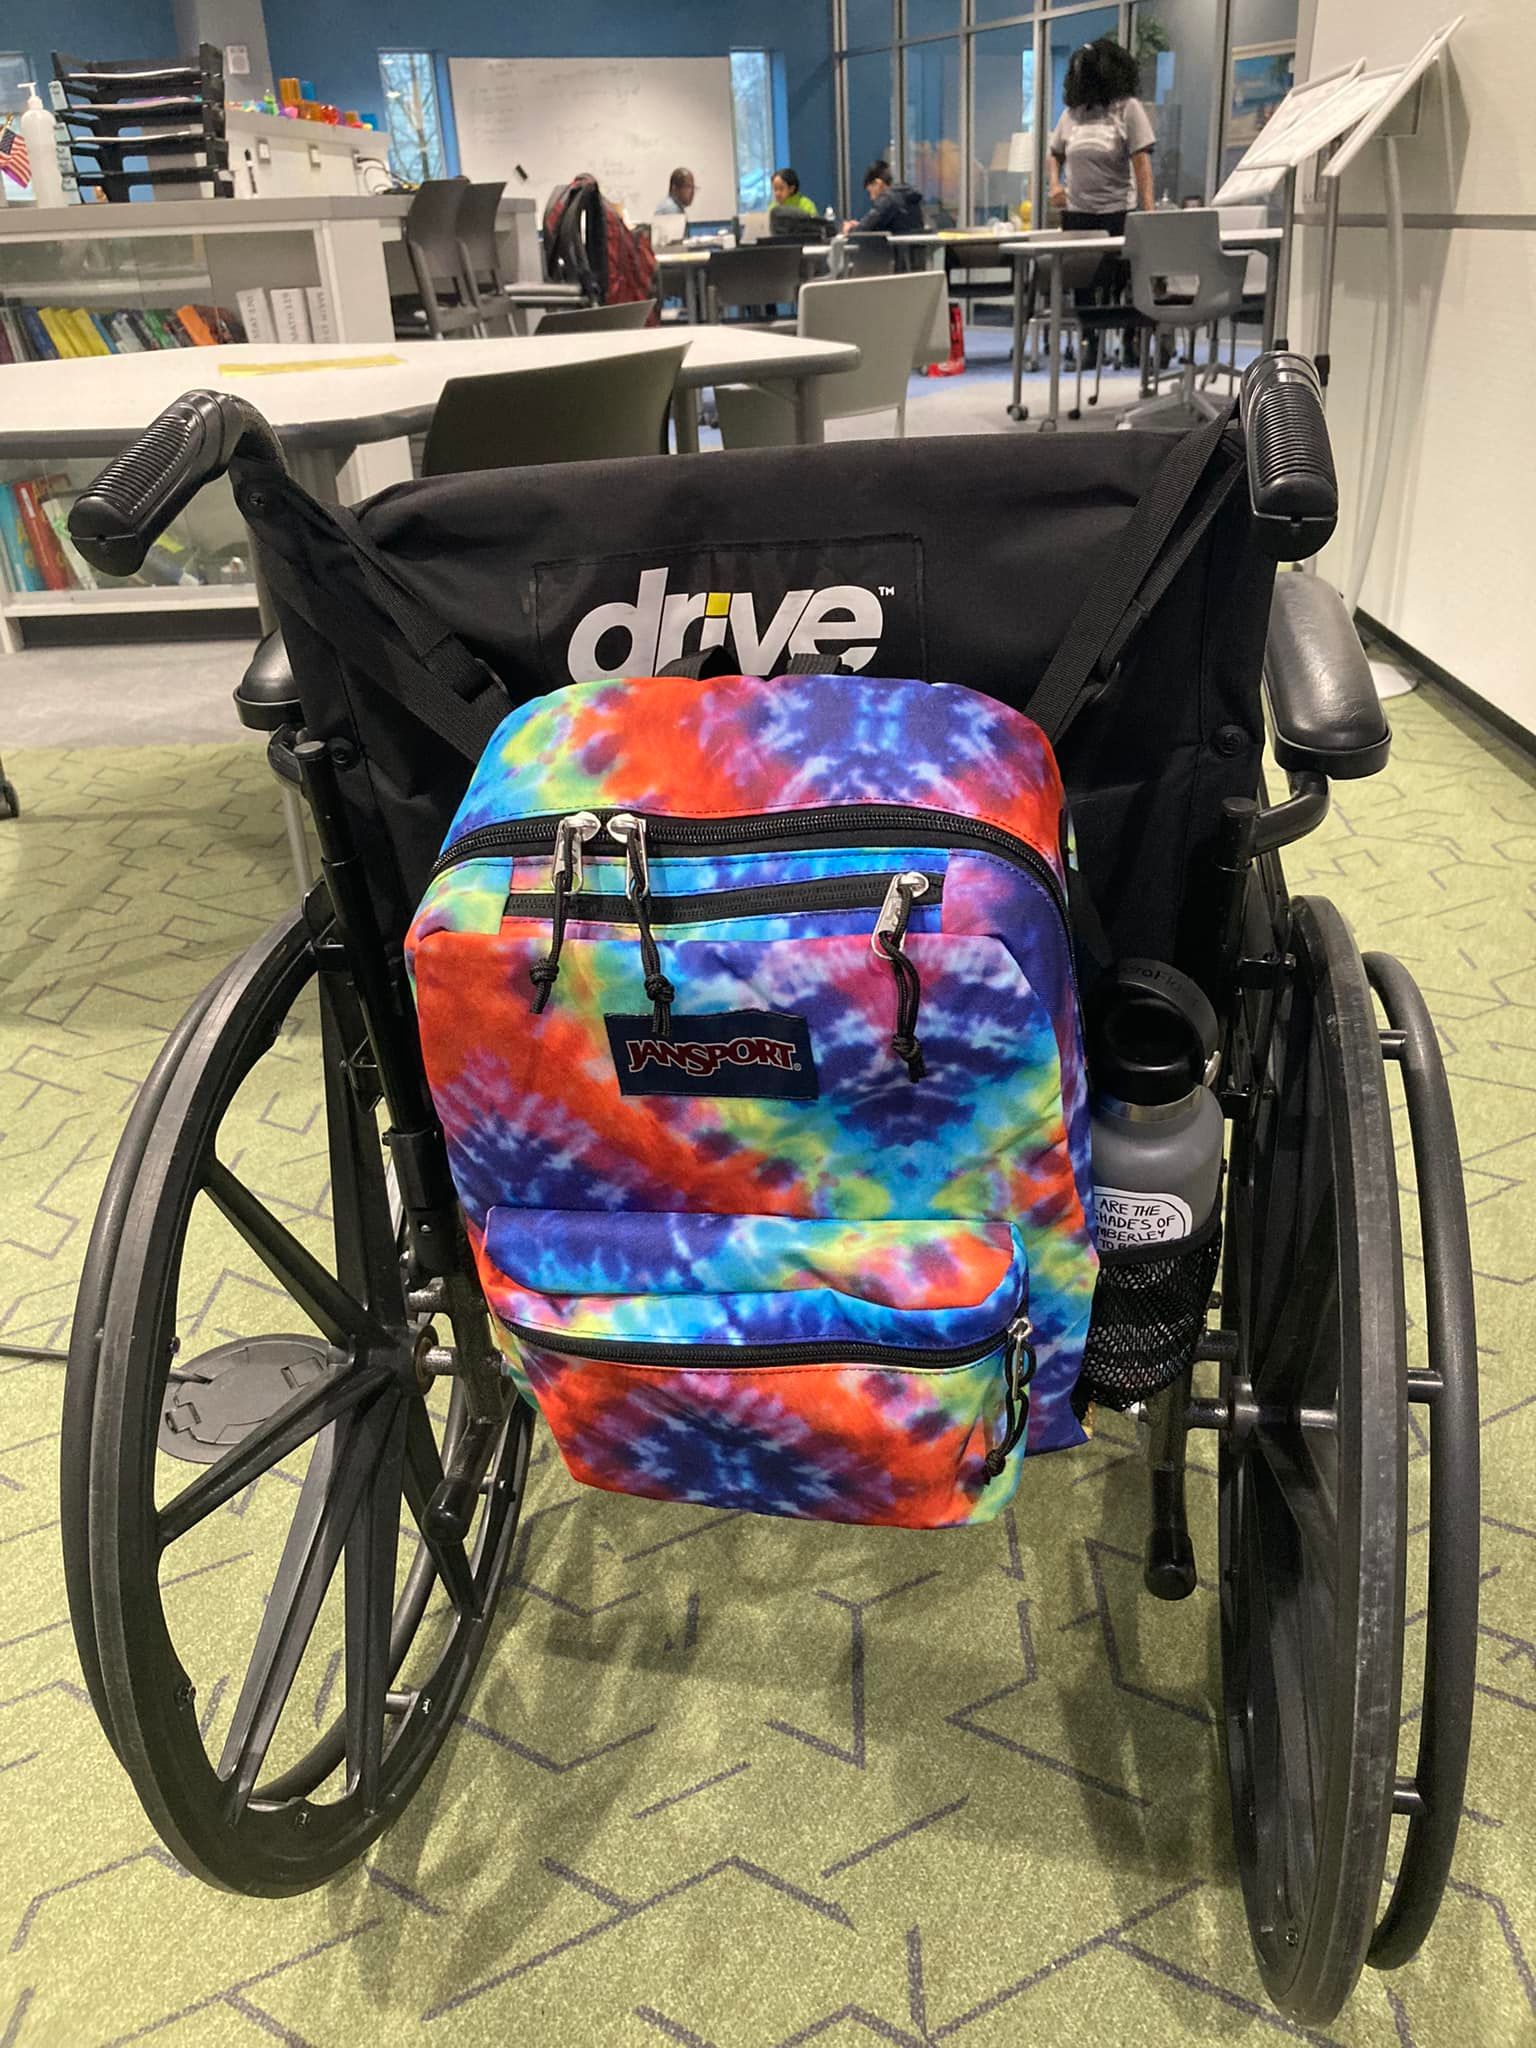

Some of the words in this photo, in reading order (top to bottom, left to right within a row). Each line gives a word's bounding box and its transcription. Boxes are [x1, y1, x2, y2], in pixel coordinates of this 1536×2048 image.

[567, 567, 883, 684] drive
[626, 1037, 796, 1076] JANSPORT
[1100, 1198, 1128, 1215] ARE
[1132, 1205, 1160, 1216] THE
[1157, 1215, 1176, 1228] OF
[1099, 1239, 1114, 1250] TO
